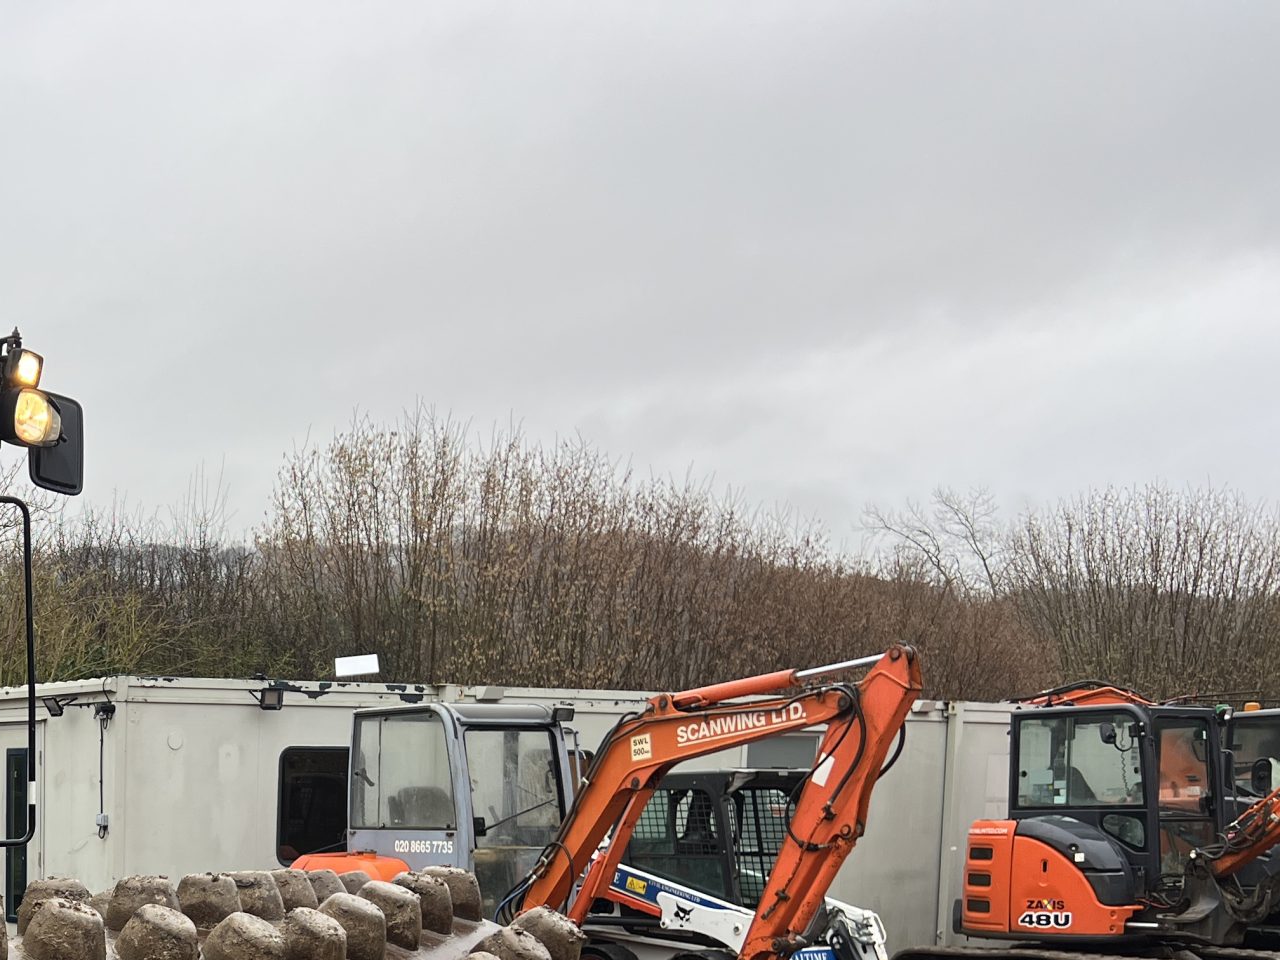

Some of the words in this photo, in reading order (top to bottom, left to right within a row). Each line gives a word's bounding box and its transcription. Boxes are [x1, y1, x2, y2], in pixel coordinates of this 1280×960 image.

[677, 712, 765, 743] SCANWING
[633, 737, 649, 746] SWL
[394, 840, 410, 853] 020
[410, 840, 431, 853] 8665
[432, 841, 453, 853] 7735
[1026, 898, 1065, 910] ZAXIS
[1019, 912, 1071, 928] 48U
